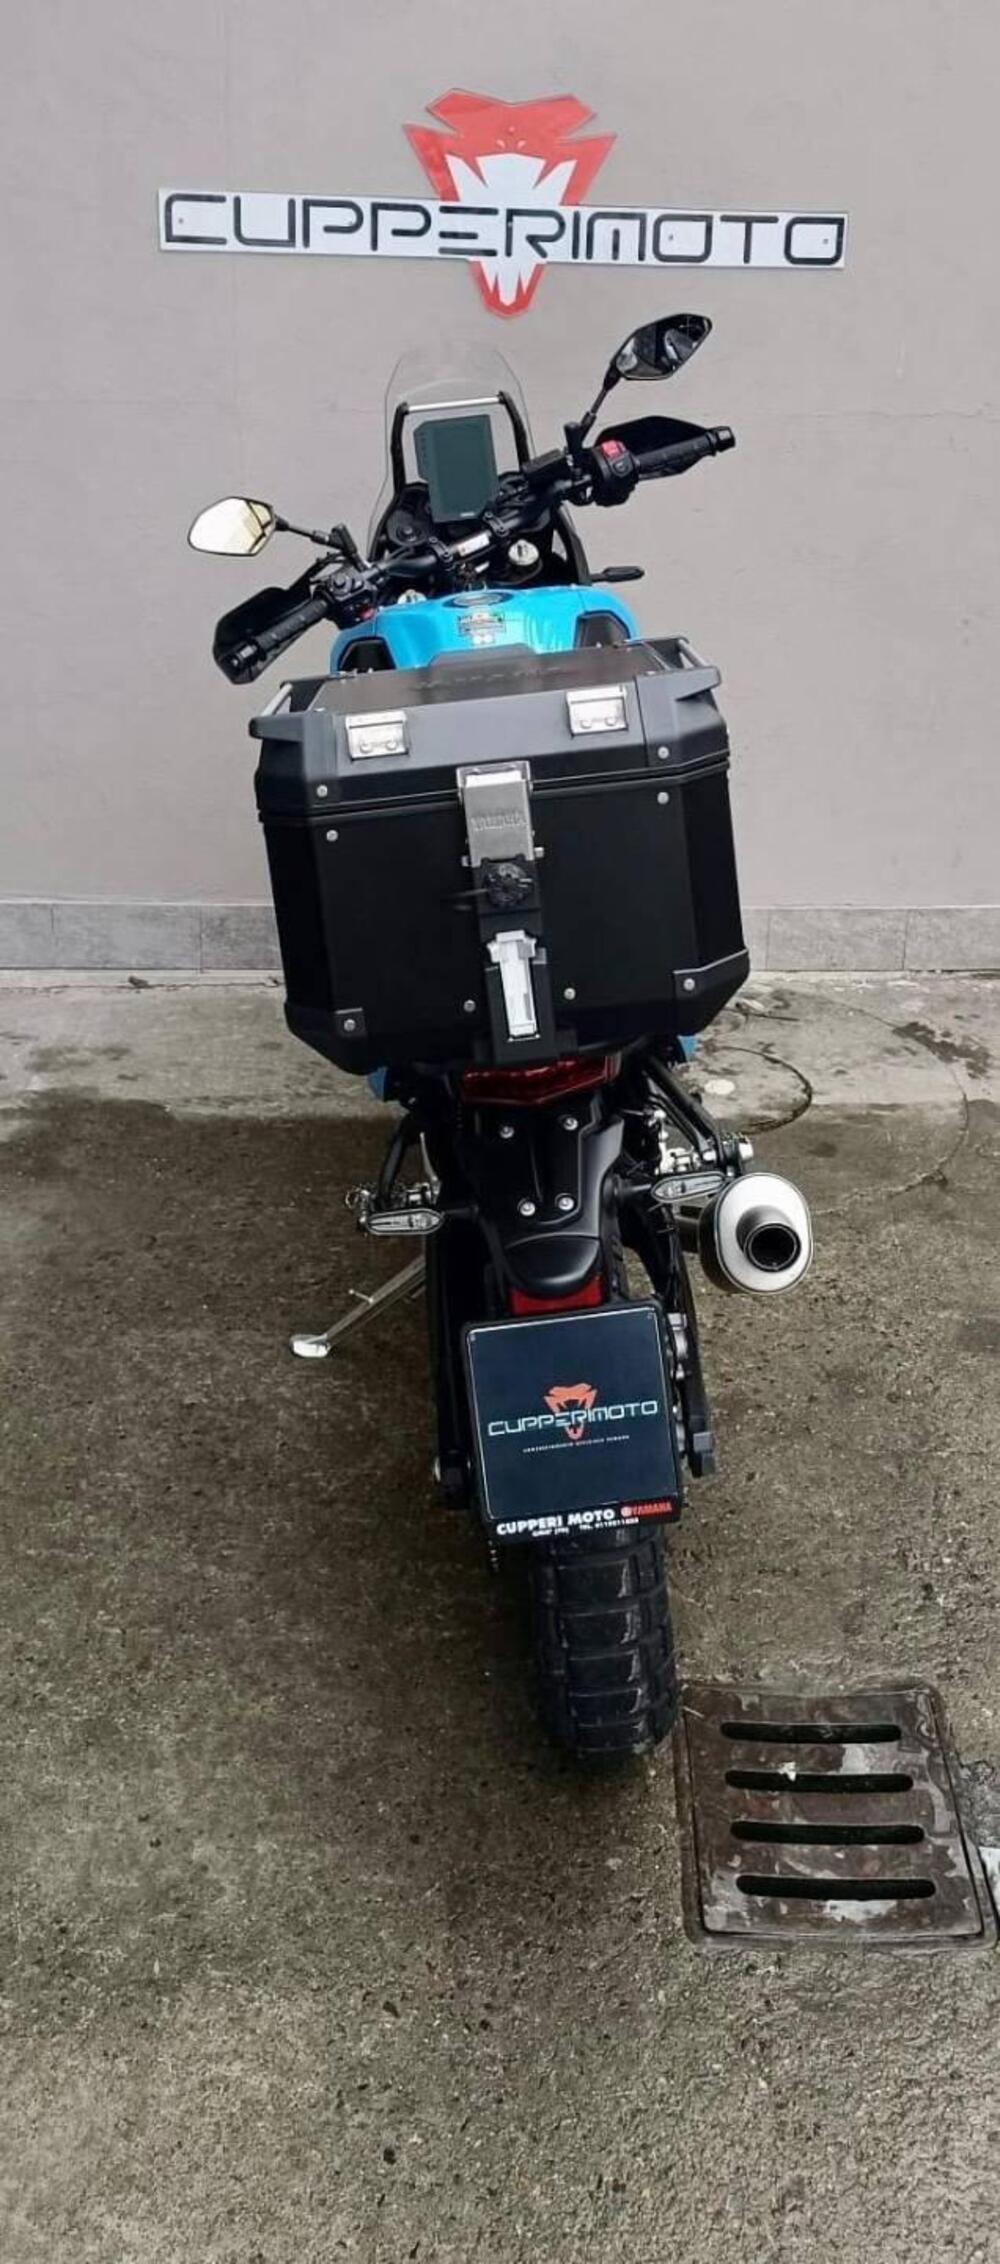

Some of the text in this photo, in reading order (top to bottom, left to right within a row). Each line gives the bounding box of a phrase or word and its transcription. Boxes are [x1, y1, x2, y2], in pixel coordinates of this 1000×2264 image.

[163, 193, 846, 266] CUPPERIMOTO
[487, 1400, 659, 1437] CUPPERIMOTO
[496, 1515, 563, 1536] CUPPERI
[567, 1508, 615, 1526] MOTO
